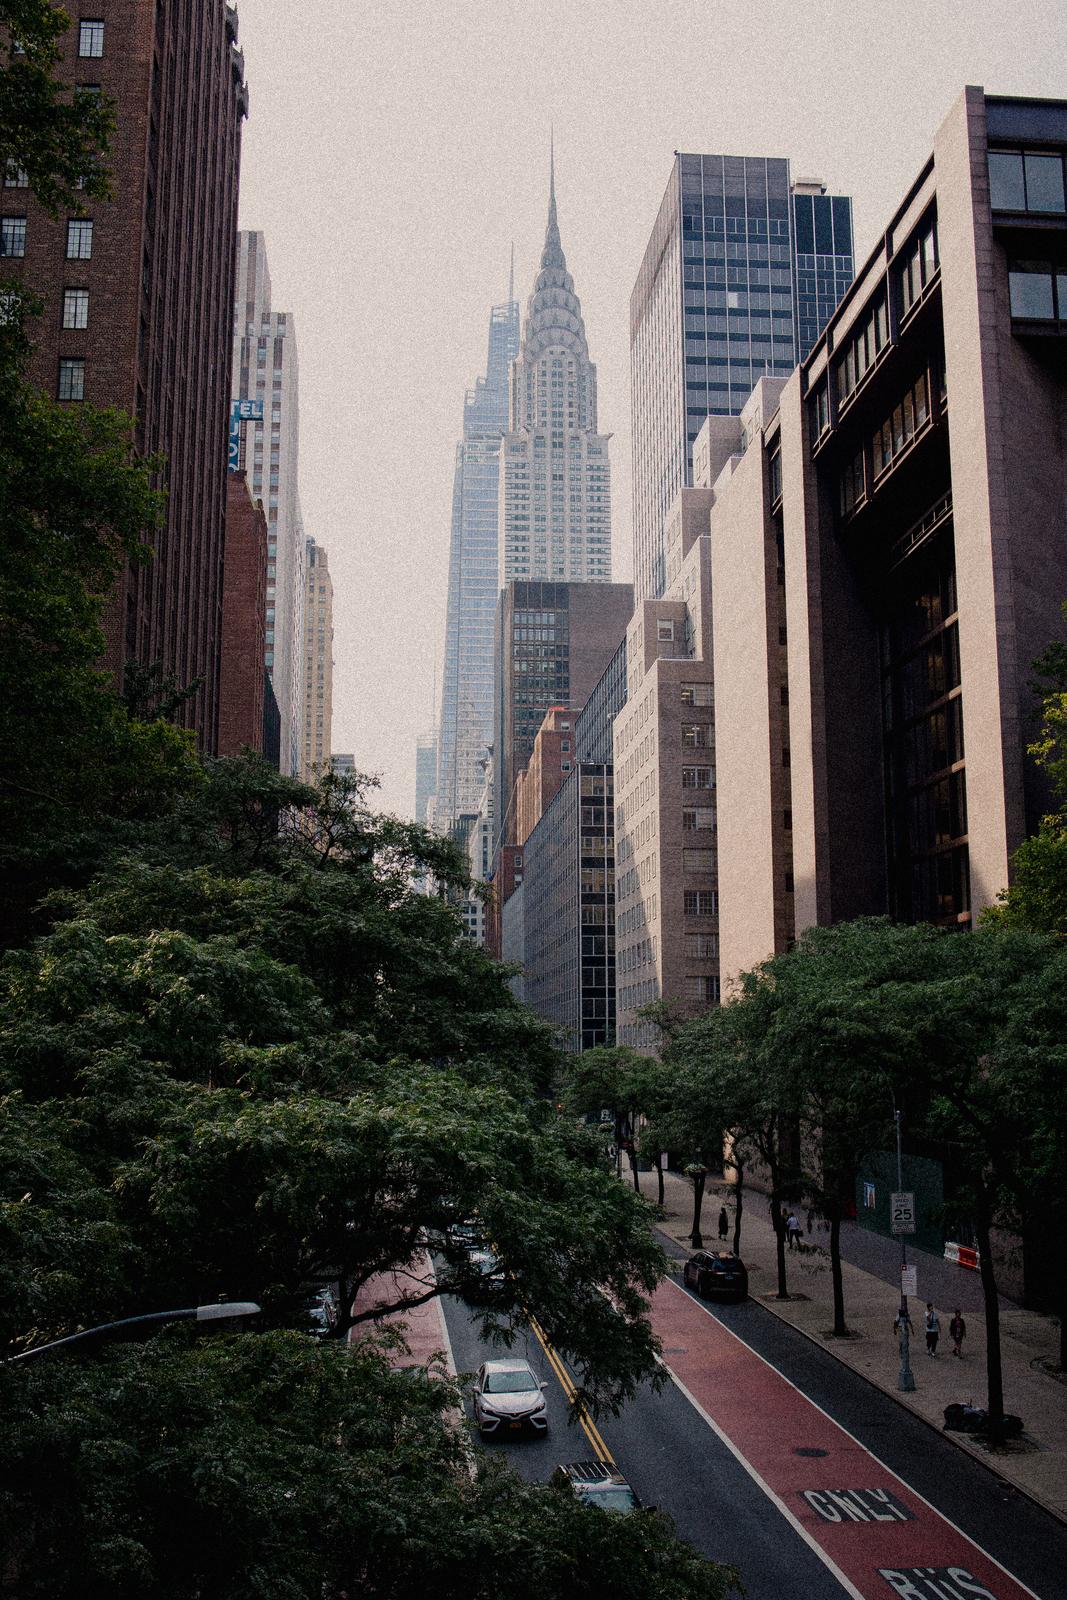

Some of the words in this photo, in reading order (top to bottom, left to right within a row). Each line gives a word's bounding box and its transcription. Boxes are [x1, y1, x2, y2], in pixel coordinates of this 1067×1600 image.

[894, 1208, 912, 1220] 25
[804, 1489, 908, 1523] ONLY
[878, 1567, 997, 1600] BUS
